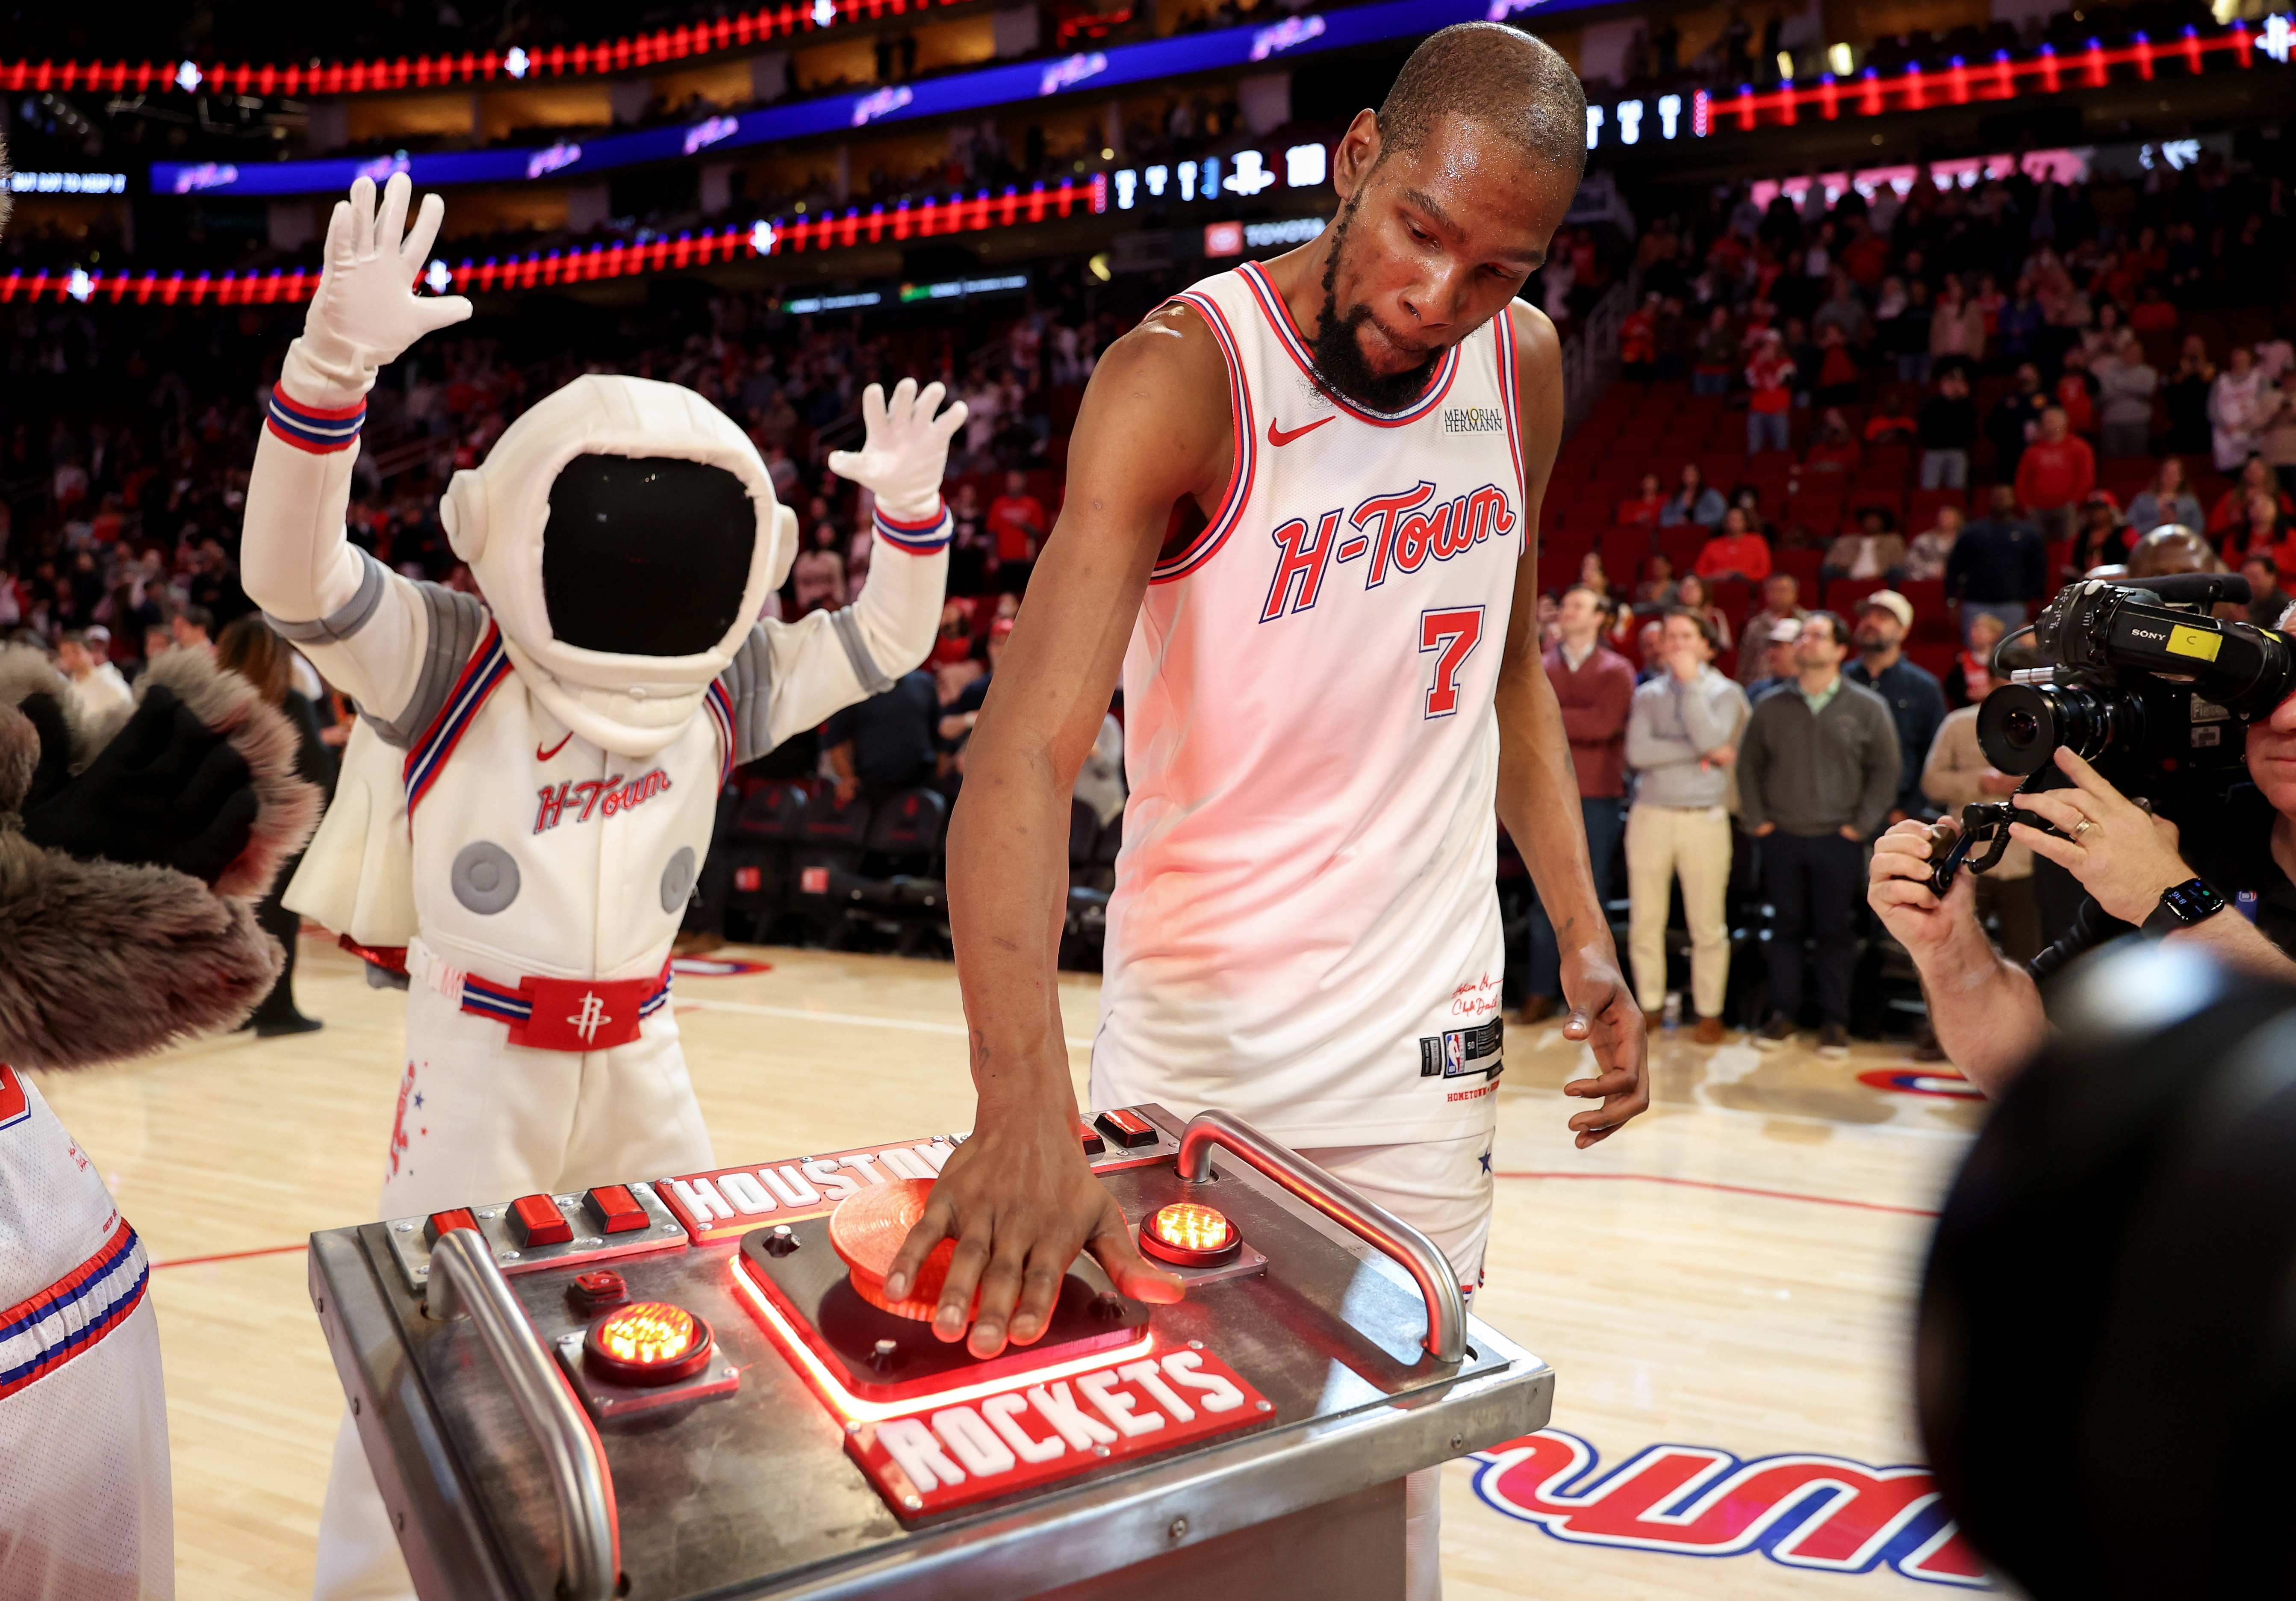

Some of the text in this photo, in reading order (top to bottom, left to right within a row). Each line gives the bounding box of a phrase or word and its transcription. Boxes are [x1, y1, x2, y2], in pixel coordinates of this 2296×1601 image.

[1444, 408, 1502, 422] MEMORIAL
[1445, 420, 1503, 432] HERMANN
[1258, 480, 1516, 624] H-Town
[2131, 628, 2166, 641] SONY
[2186, 636, 2197, 645] C
[1419, 605, 1485, 720] 7
[533, 767, 672, 835] H-Town
[875, 1349, 1245, 1494] ROCKETS
